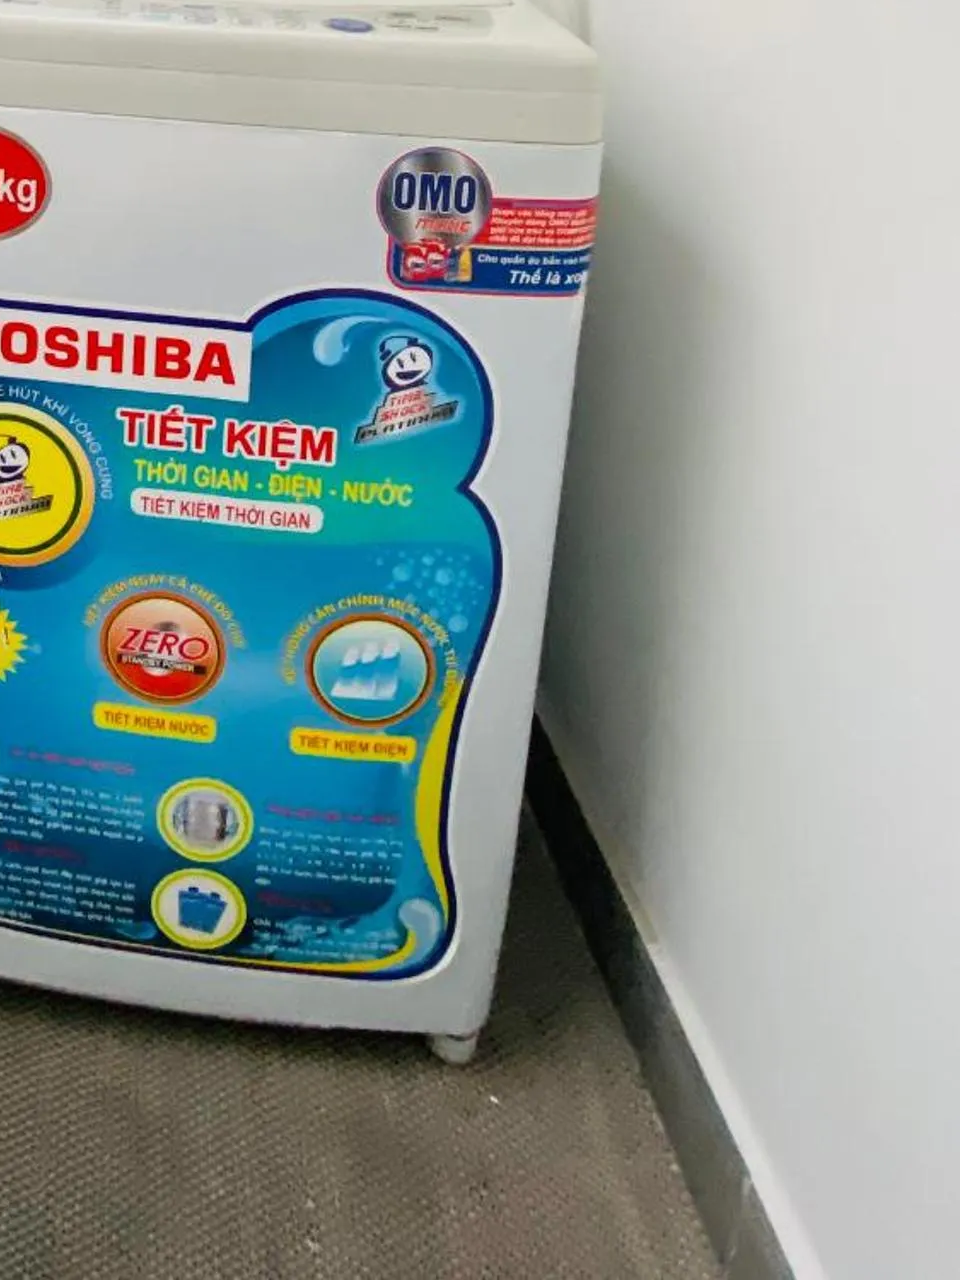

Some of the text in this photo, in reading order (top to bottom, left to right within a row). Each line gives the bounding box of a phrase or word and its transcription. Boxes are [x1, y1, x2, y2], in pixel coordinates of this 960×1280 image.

[393, 171, 477, 214] OMO
[8, 384, 41, 402] HÚT
[119, 407, 336, 468] TIẾT KIỆM
[134, 458, 187, 486] THỜI
[193, 466, 249, 493] GIAN
[268, 472, 323, 503] ĐIỆN
[342, 479, 415, 508] NƯỚC
[141, 494, 312, 530] TIẾT KIỆM THỜI GIAN
[119, 627, 210, 661] ZERO
